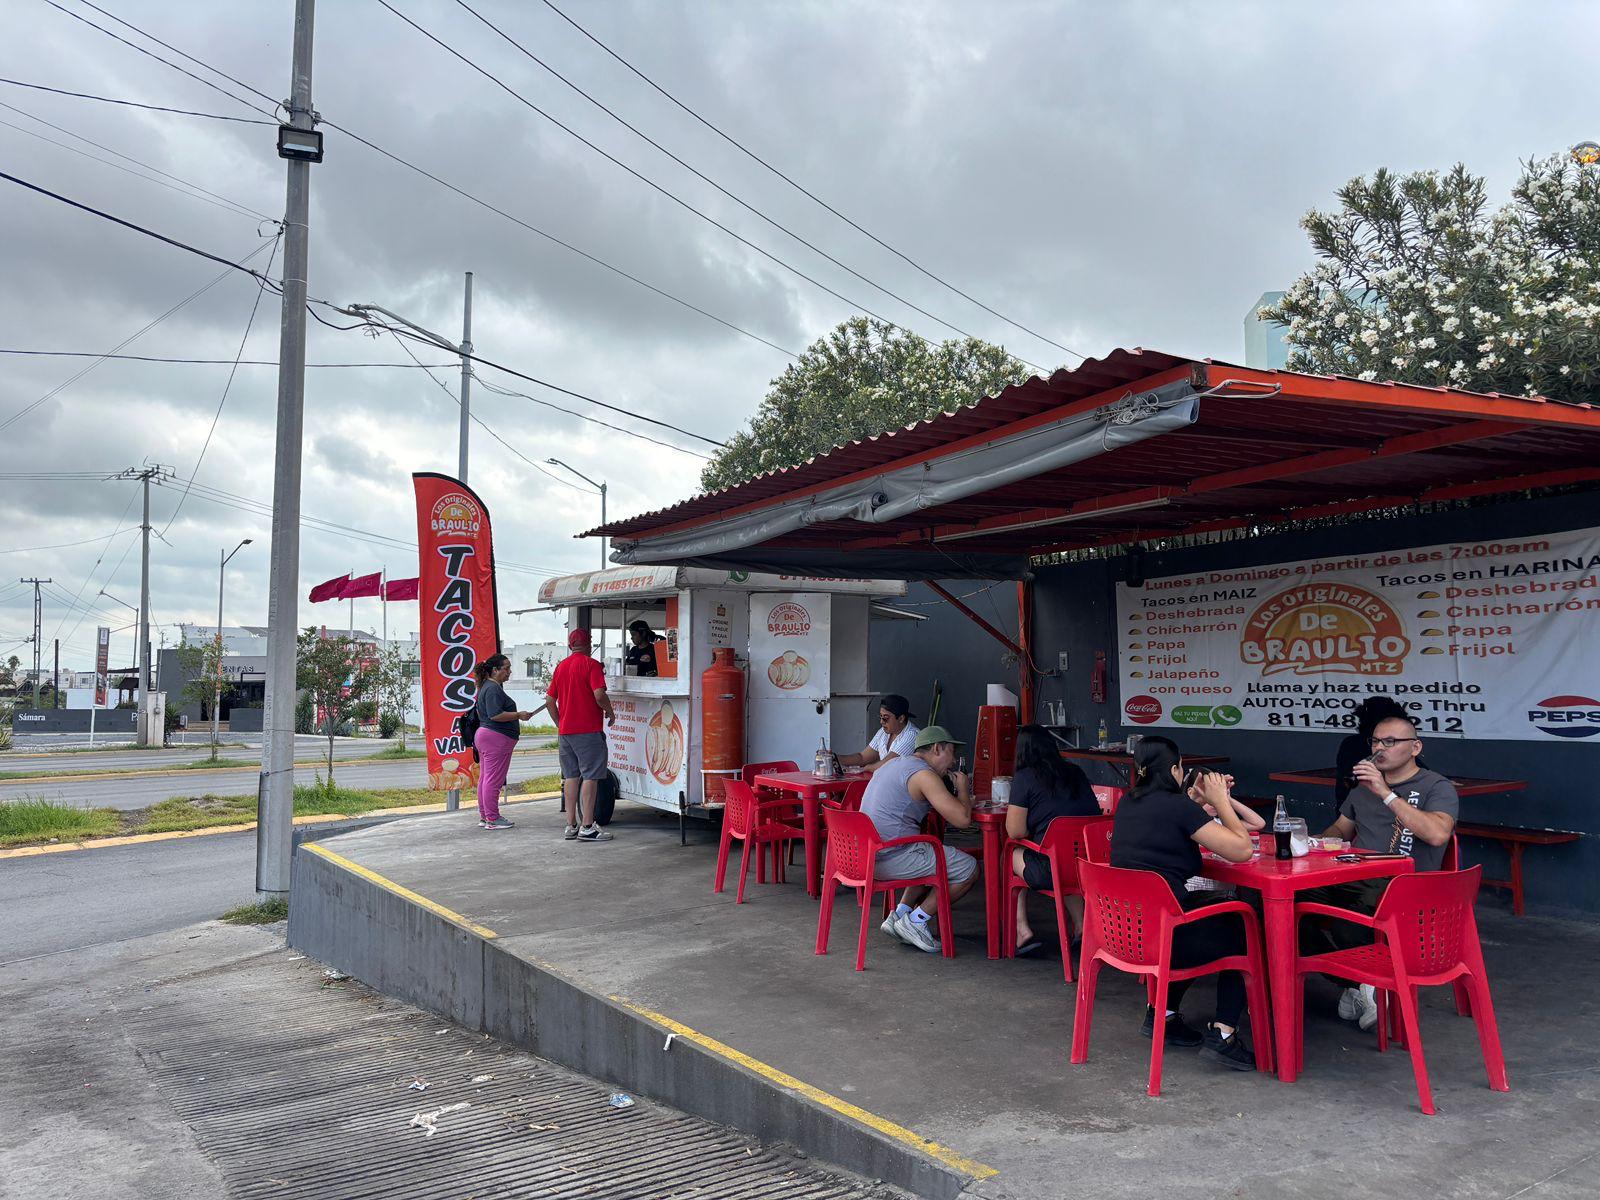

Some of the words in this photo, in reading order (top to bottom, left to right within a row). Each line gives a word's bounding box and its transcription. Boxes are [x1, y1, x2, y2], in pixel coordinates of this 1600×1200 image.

[451, 508, 462, 517] De
[431, 519, 480, 531] BRAULIO
[1145, 576, 1191, 591] Lunes
[1196, 577, 1205, 585] a
[1209, 567, 1290, 583] Domingo
[1295, 564, 1307, 574] a
[1311, 555, 1368, 575] partir
[1374, 555, 1401, 567] de
[1407, 550, 1443, 564] las
[1449, 541, 1549, 560] 7:00am
[1376, 571, 1447, 587] Tacos
[1453, 570, 1482, 580] en
[1489, 555, 1600, 578] HARINA
[592, 576, 654, 593] 8114851212
[1445, 575, 1597, 600] Deshebrad
[1141, 597, 1186, 607] Tacos
[1188, 595, 1209, 603] en
[1213, 588, 1257, 601] MAIZ
[1146, 605, 1245, 621] Deshebrada
[1446, 597, 1600, 618] Chicharrón
[1252, 604, 1281, 629] Los
[1300, 613, 1338, 631] De
[434, 546, 478, 712] TACOS
[768, 622, 810, 632] BRAULIO
[1146, 622, 1237, 636] Chicharrón
[1447, 625, 1512, 639] Papa
[1147, 641, 1186, 652] Papa
[1242, 635, 1406, 662] BRAULIO
[1447, 643, 1516, 658] Frijol
[1147, 654, 1187, 666] Frijol
[222, 665, 254, 673] ENTAS
[1361, 662, 1398, 673] MTZ
[1147, 669, 1220, 681] Jalapeño
[1149, 686, 1176, 694] con
[1180, 686, 1232, 696] queso
[1247, 682, 1301, 693] Llama
[1308, 684, 1319, 696] y
[1324, 682, 1360, 693] haz
[1365, 682, 1387, 693] tu
[1394, 682, 1481, 696] pedido
[1242, 697, 1357, 709] AUTO-TACO
[1428, 699, 1486, 712] Thru
[18, 712, 46, 721] Sámara
[1267, 712, 1464, 732] 811-48212
[1528, 710, 1600, 723] PEPS
